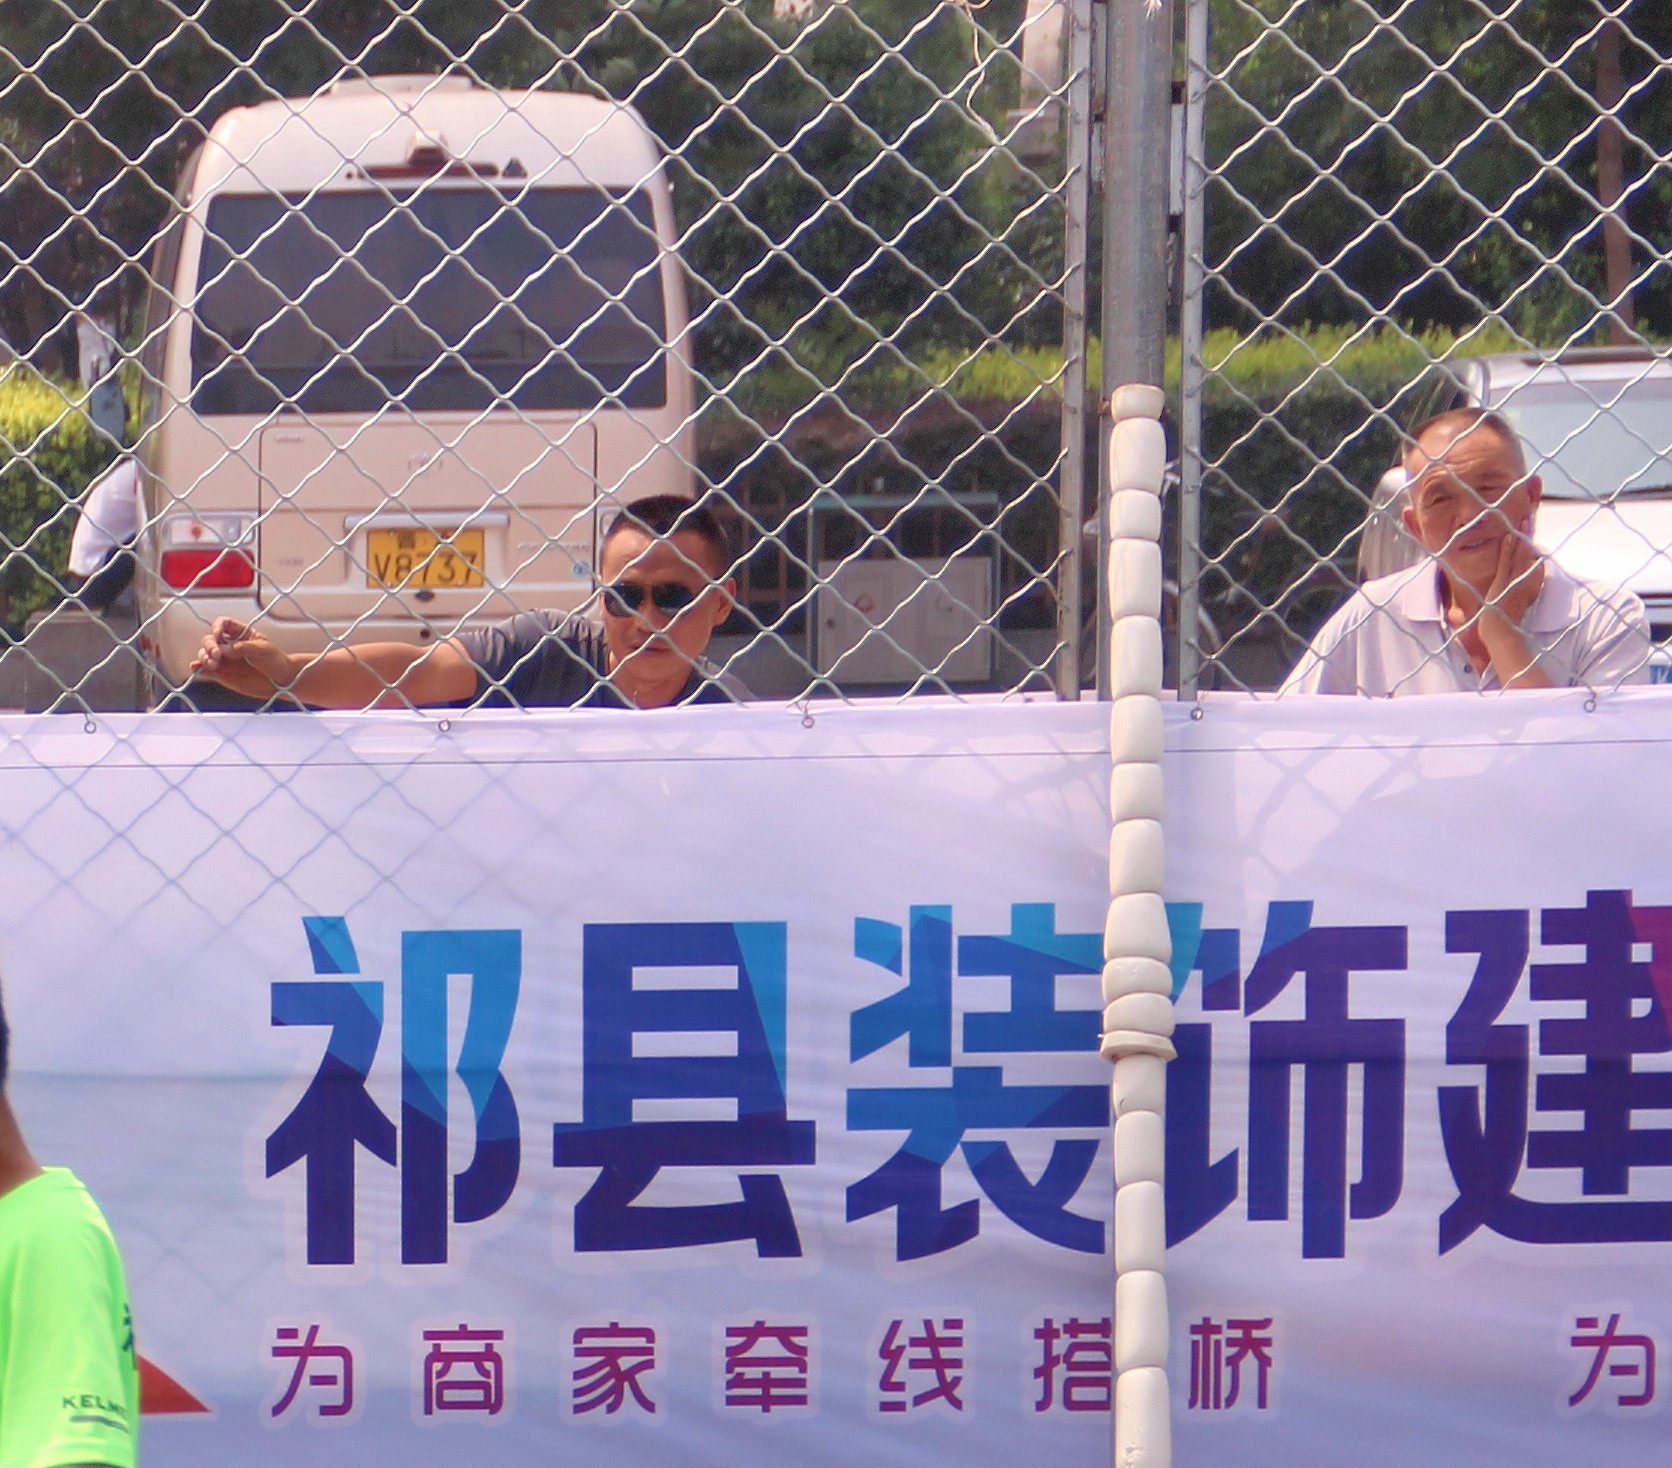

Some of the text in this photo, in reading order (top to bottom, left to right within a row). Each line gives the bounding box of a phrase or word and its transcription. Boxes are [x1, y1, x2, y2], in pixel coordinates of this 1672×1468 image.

[271, 1313, 1659, 1416] 为商家牵线搭桥 为
